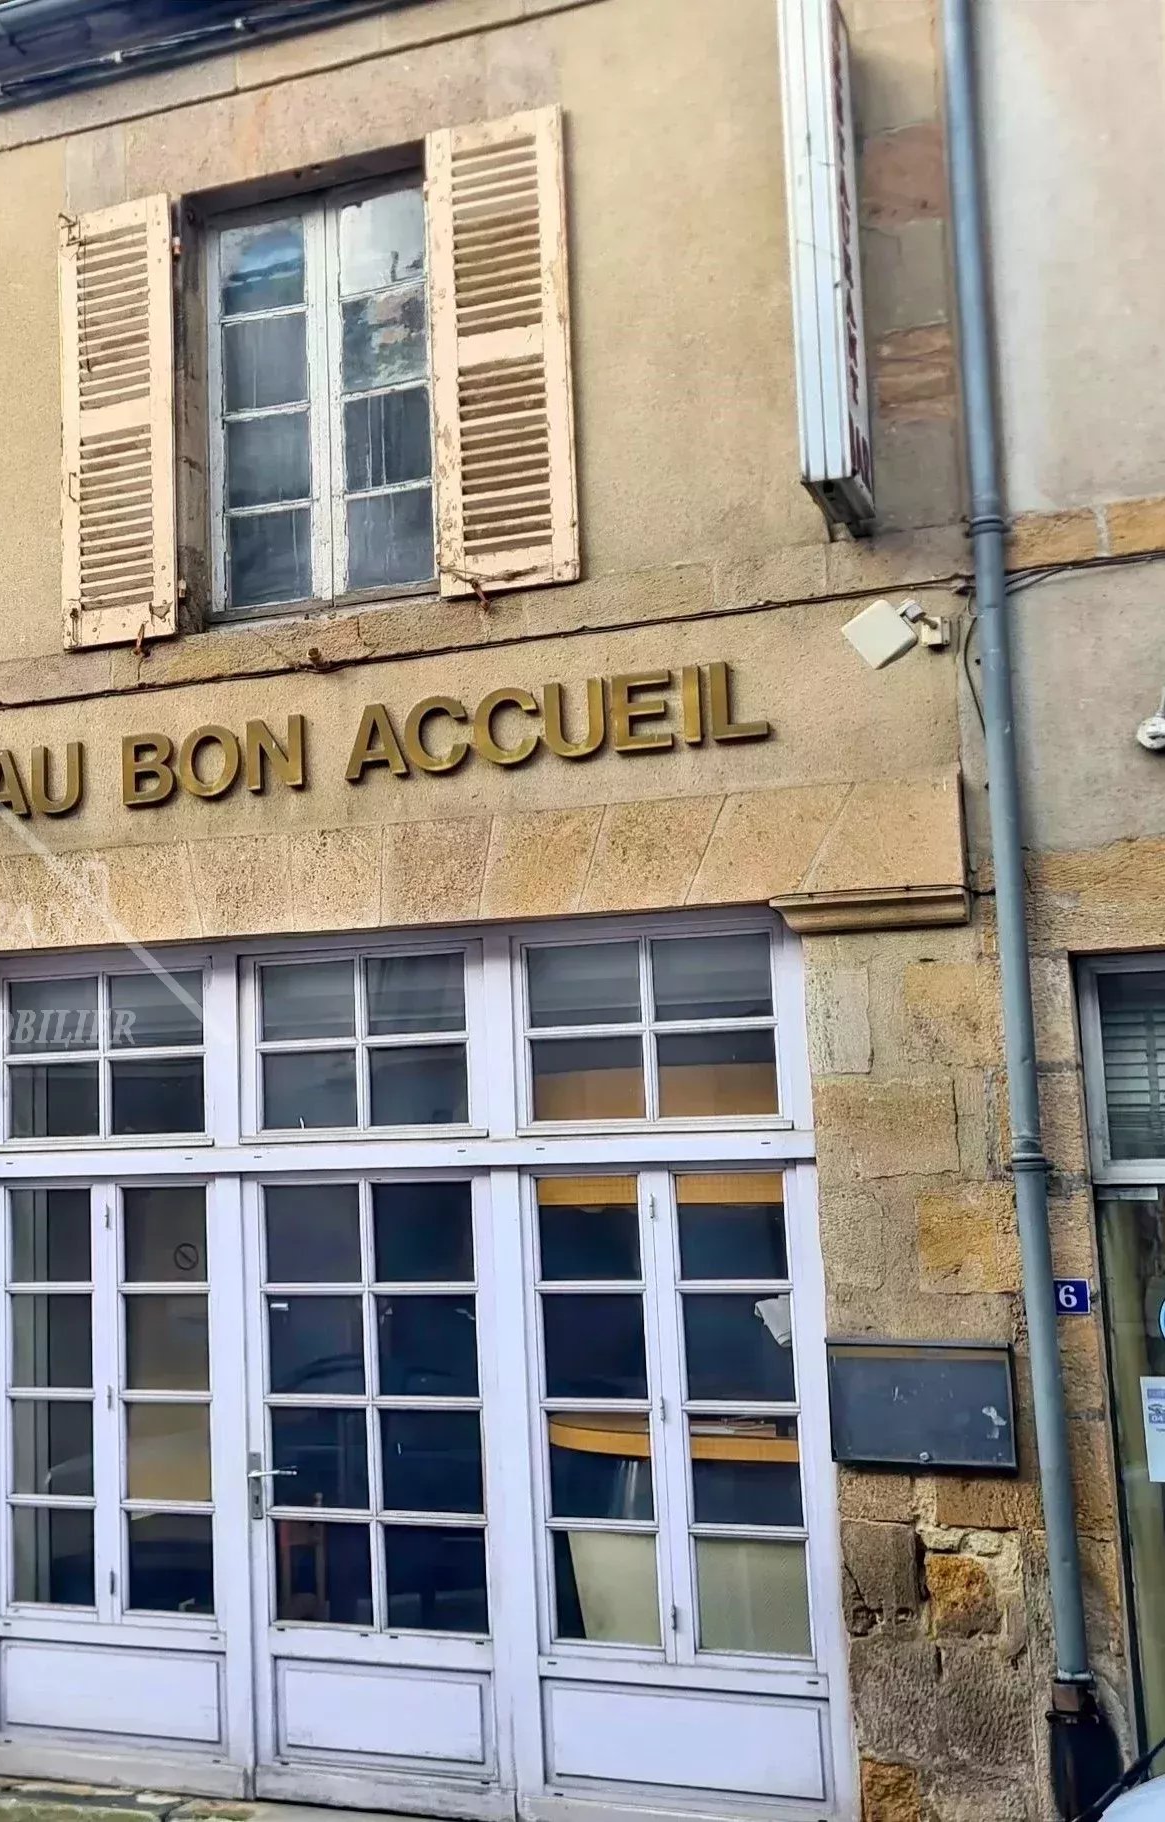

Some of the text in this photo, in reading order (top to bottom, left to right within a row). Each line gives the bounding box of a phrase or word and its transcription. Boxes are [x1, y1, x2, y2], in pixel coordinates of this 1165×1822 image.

[121, 713, 306, 807] BON
[344, 661, 771, 783] ACCUEIL
[1059, 1285, 1078, 1308] 6
